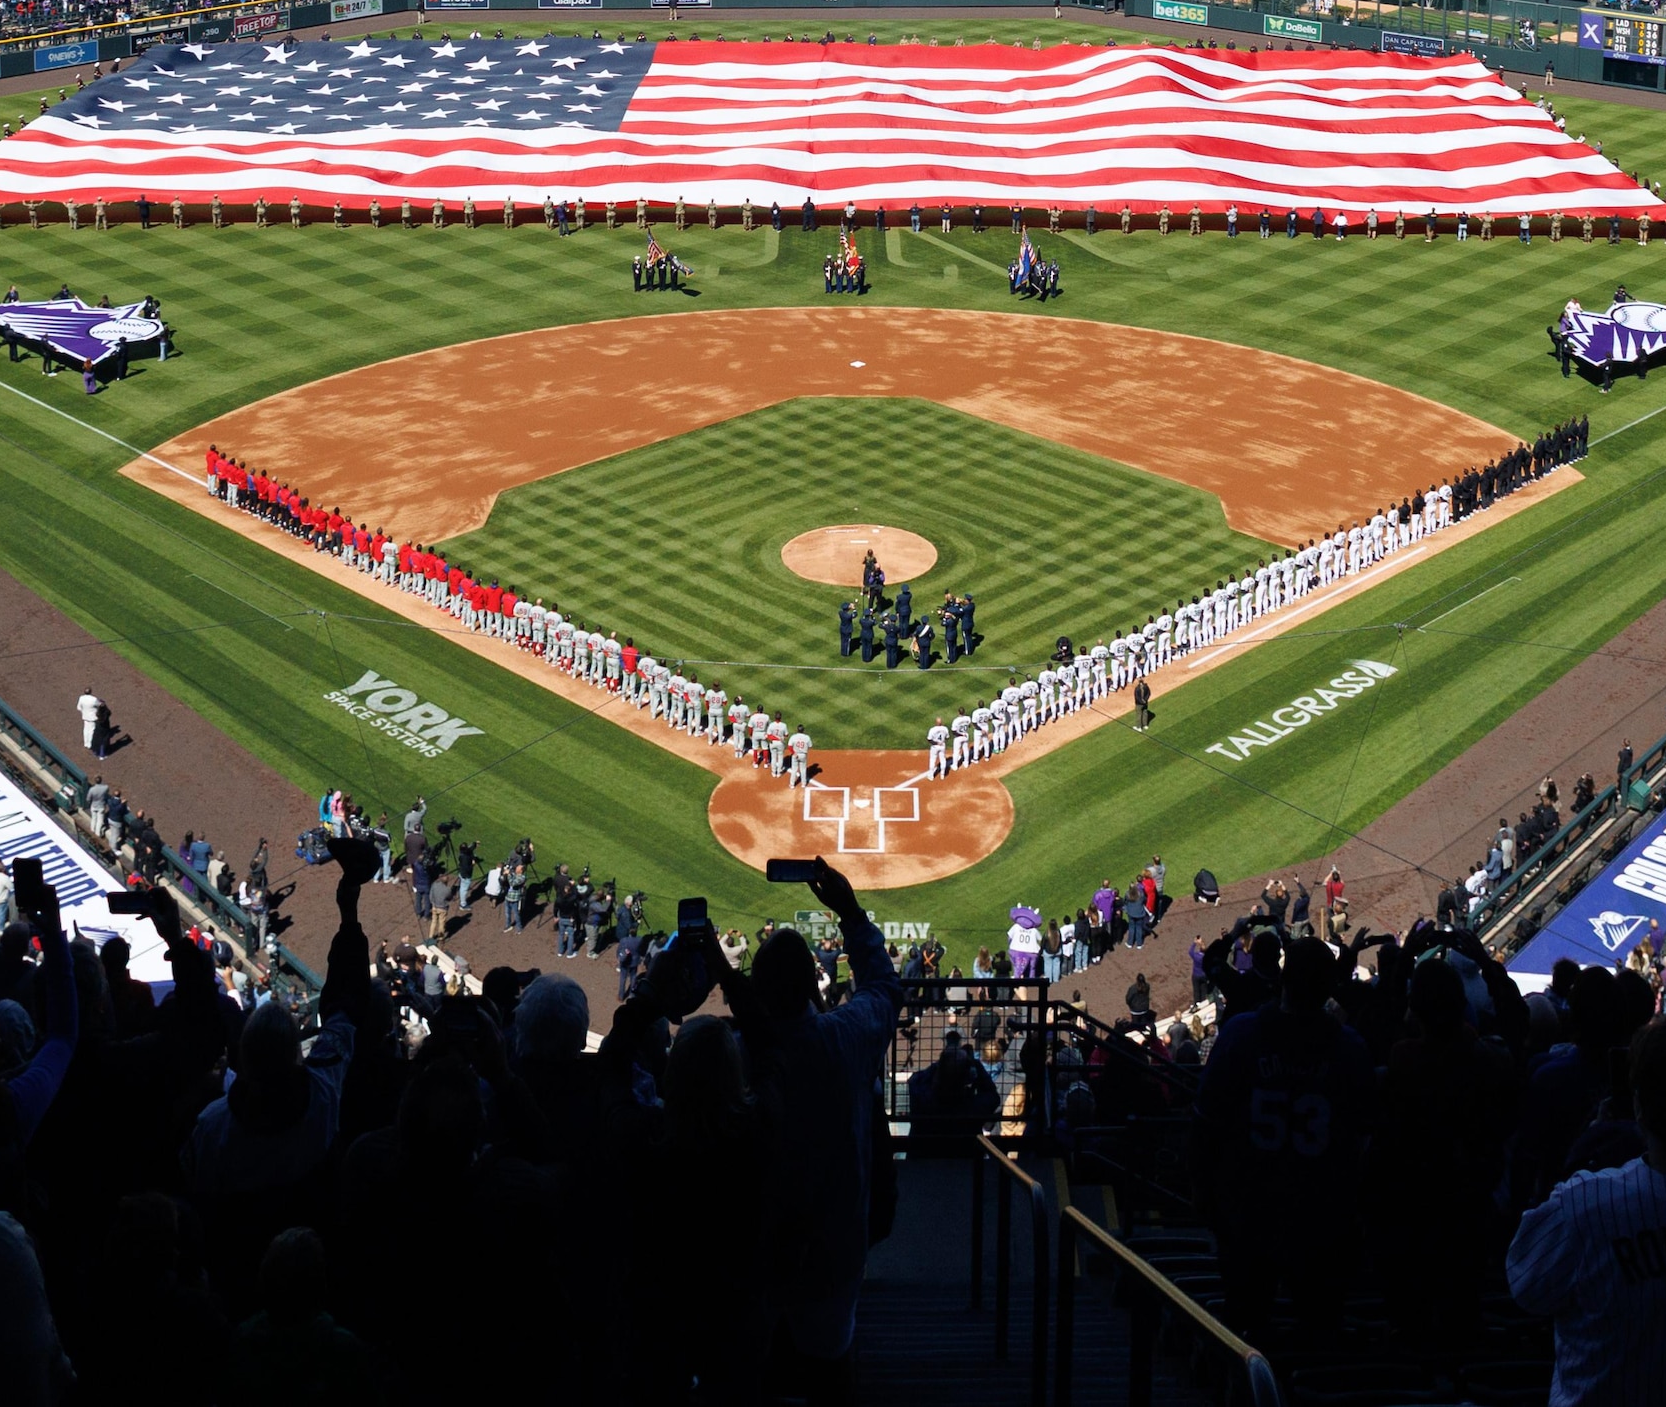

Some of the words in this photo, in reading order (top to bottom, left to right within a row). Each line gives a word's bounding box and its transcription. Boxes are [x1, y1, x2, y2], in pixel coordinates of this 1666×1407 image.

[352, 1, 365, 10] 24/7
[1155, 2, 1205, 22] bet365
[1286, 23, 1316, 34] DaBella
[1616, 19, 1629, 27] LAD
[1647, 23, 1658, 31] 80
[205, 28, 219, 36] 390
[1385, 36, 1401, 44] DAN
[1615, 36, 1626, 44] STL
[341, 669, 485, 751] YORK
[1205, 665, 1381, 761] TALLGRASS
[323, 691, 376, 721] SPACE
[370, 717, 443, 758] SYSTEMS
[886, 922, 930, 939] DAY
[1020, 934, 1030, 943] 00
